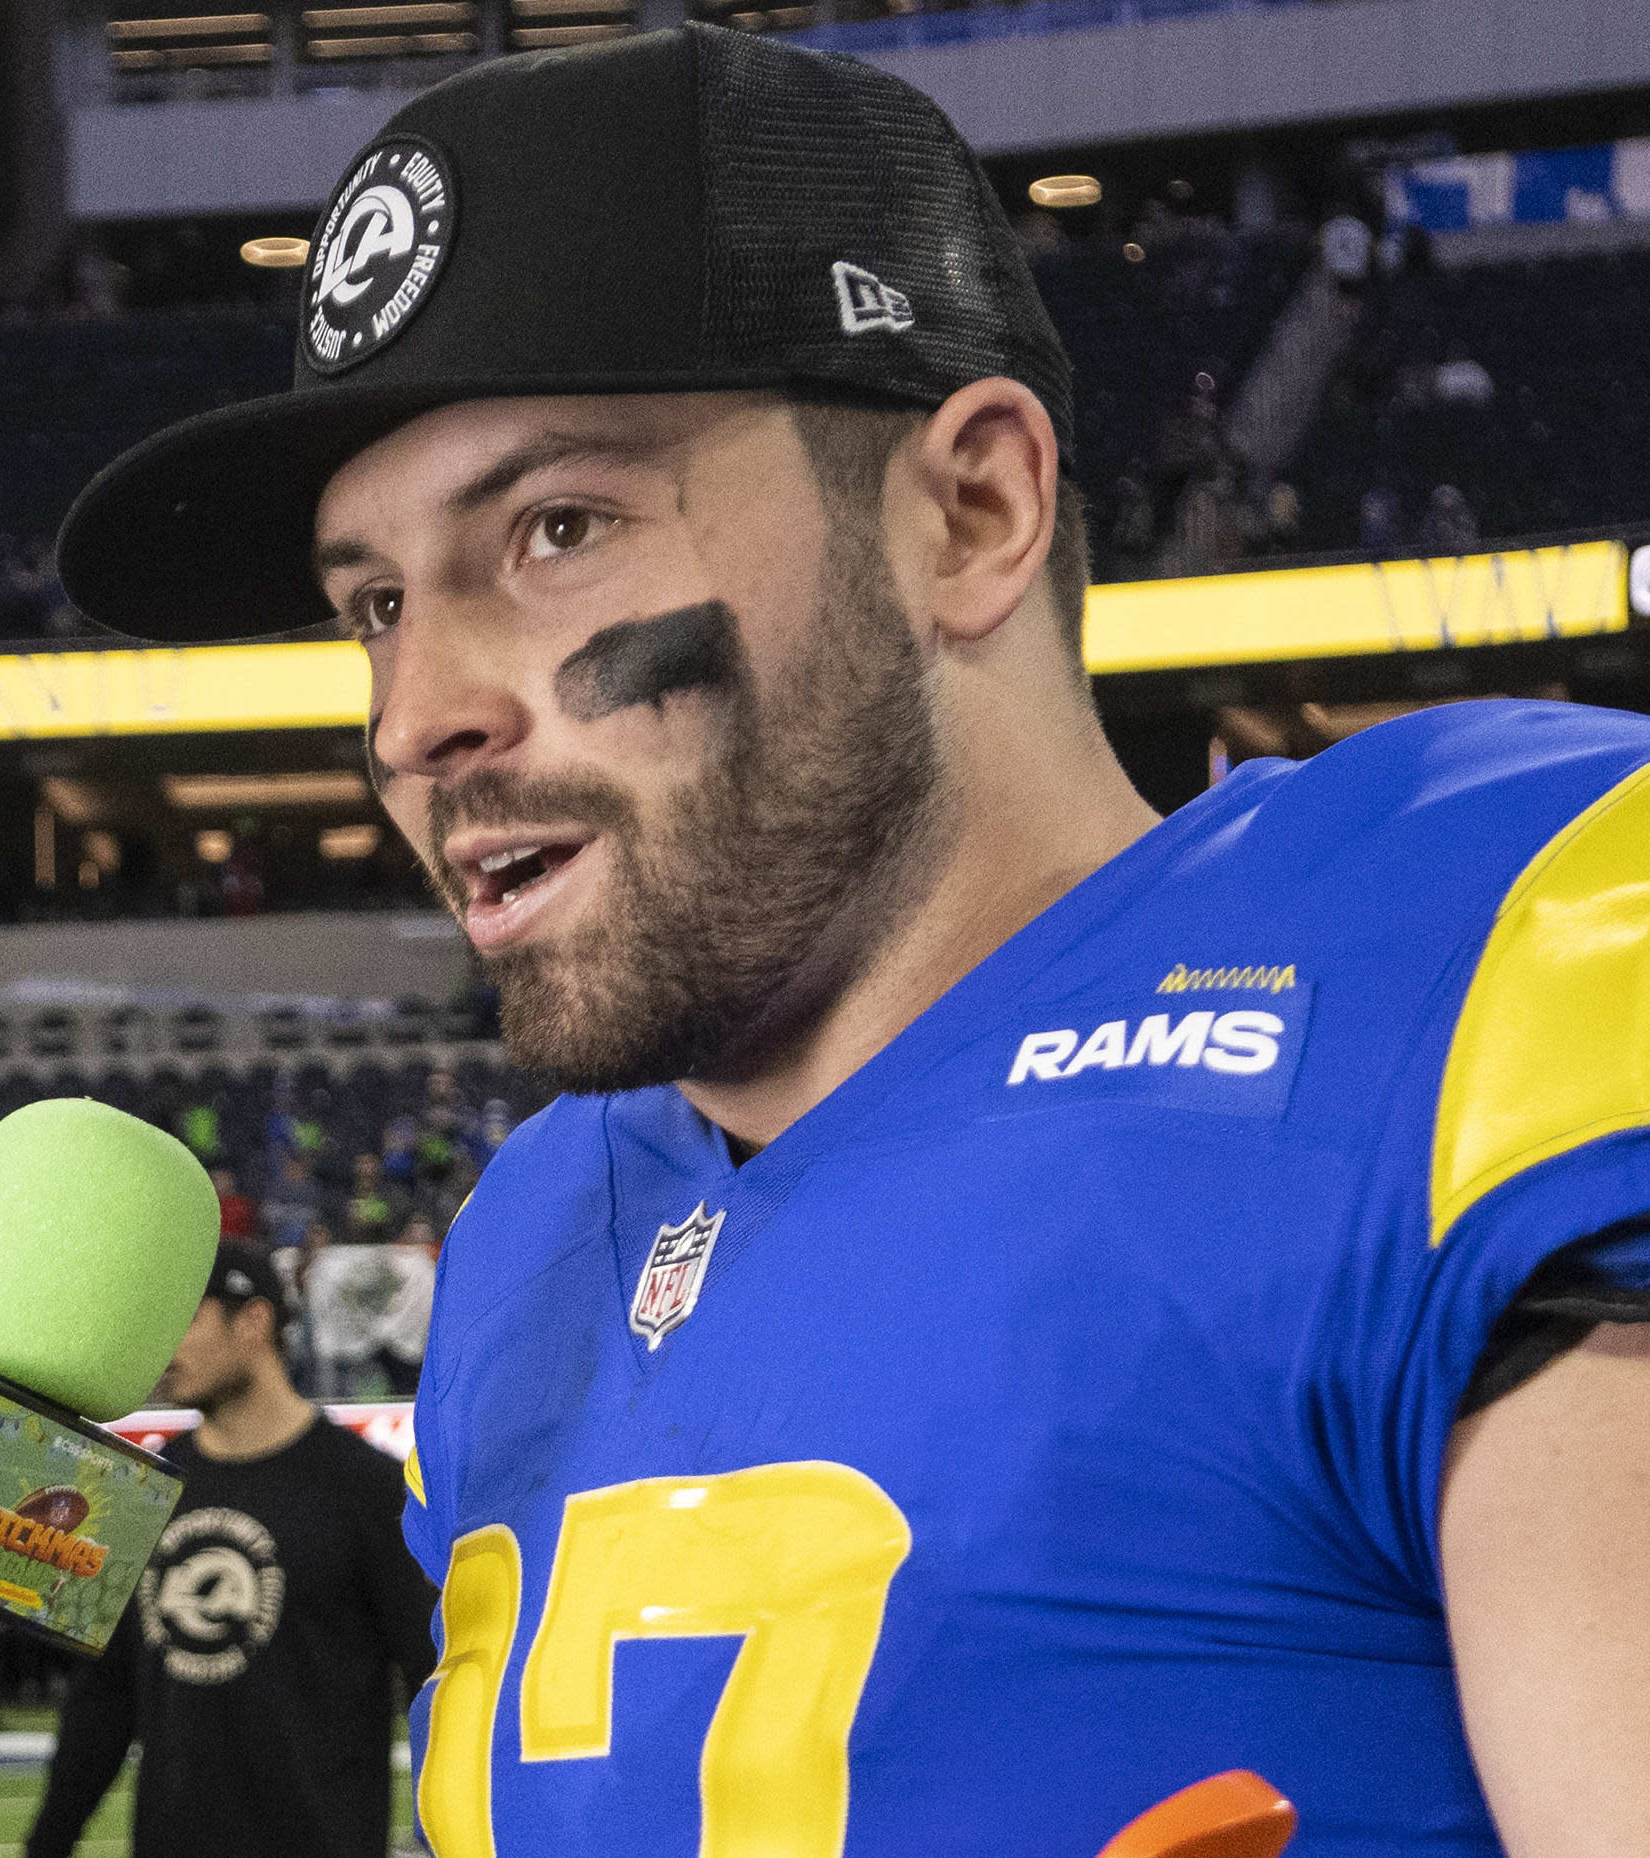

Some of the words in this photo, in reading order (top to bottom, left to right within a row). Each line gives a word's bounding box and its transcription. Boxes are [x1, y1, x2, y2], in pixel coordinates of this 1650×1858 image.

[311, 151, 384, 282] OPPORTUNITY
[401, 151, 446, 213] EQUITY
[372, 244, 441, 339] FREEDOM
[1006, 1010, 1286, 1086] RAMS
[640, 1263, 691, 1319] NFL
